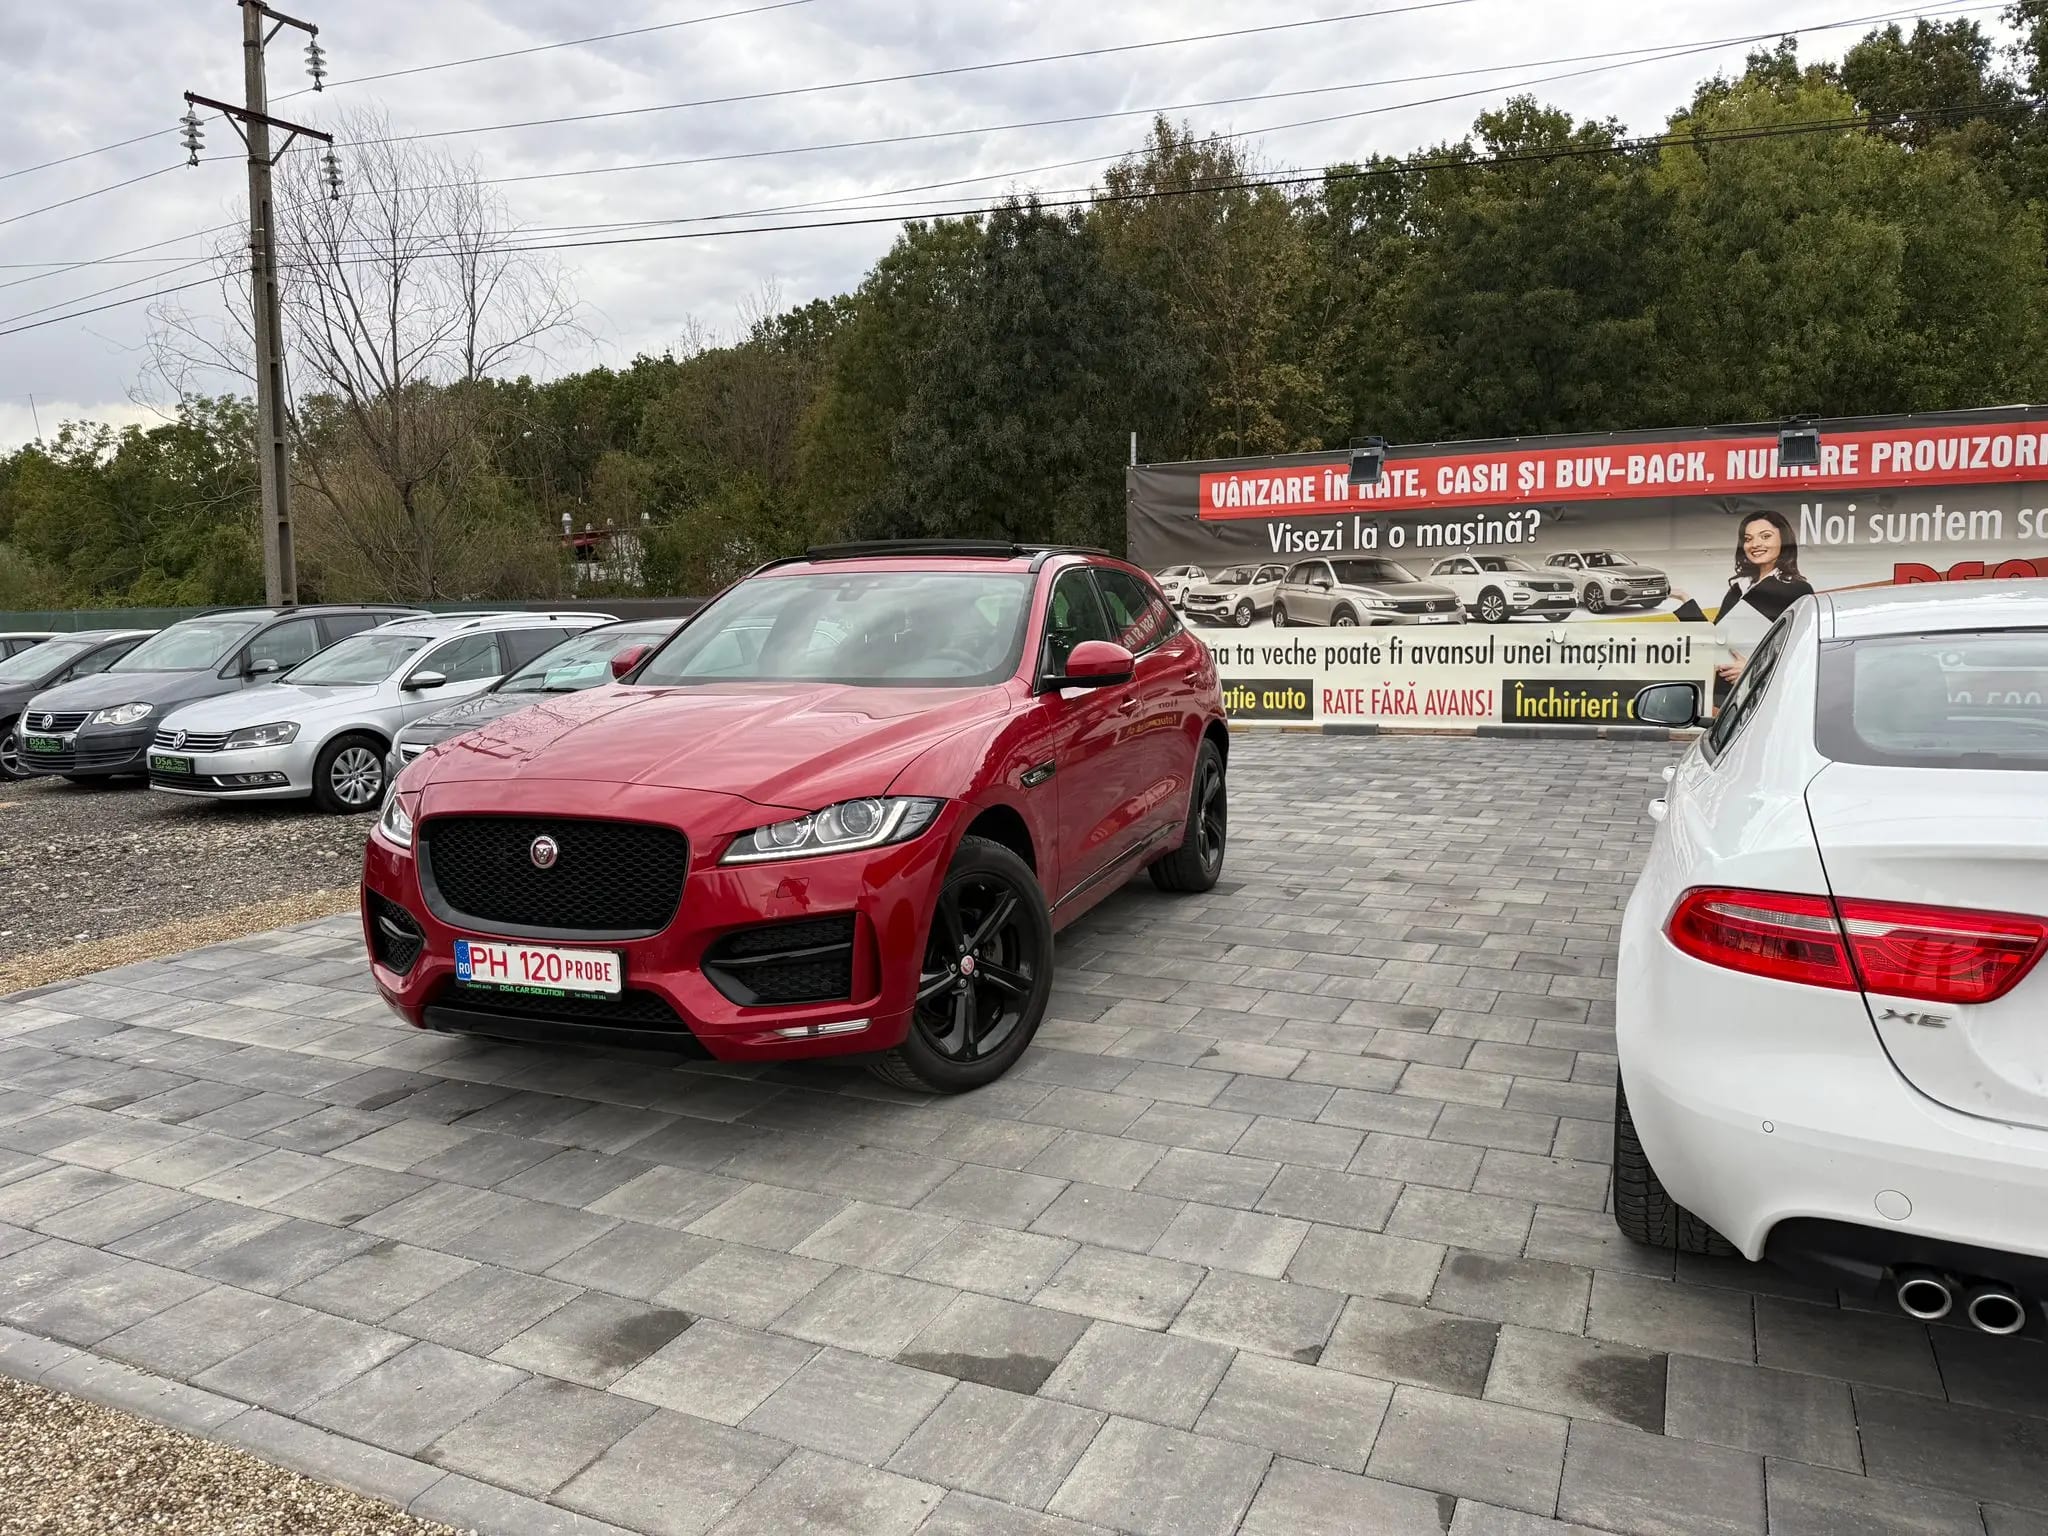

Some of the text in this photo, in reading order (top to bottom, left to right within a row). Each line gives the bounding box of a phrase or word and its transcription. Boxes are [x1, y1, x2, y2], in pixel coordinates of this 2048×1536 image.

[1211, 475, 1315, 508] VÂNZARE
[1324, 469, 1348, 501] ÎN
[1437, 463, 1507, 495] CASH
[1517, 460, 1545, 496] ȘI
[1267, 509, 1541, 553] Visezi la o mașină?
[1800, 503, 1856, 545] Noi
[1869, 505, 2002, 543] suntem
[1236, 643, 1254, 665] ta
[1262, 637, 1316, 665] veche
[1325, 642, 1381, 671] poate
[1389, 636, 1403, 665] fi
[1411, 634, 1494, 665] avansul
[1503, 638, 1551, 664] unei
[1560, 637, 1636, 671] mașini
[1646, 636, 1691, 664] noi!
[1263, 687, 1306, 710] auto
[1323, 681, 1493, 716] RATE FĂRĂ AVANS!
[1515, 681, 1619, 718] Închirieri
[155, 757, 172, 766] DSA
[458, 962, 471, 976] RO
[470, 946, 613, 983] PH 120 PROBE
[499, 984, 514, 993] DSA
[515, 986, 530, 994] CAR
[530, 987, 565, 997] SOLUTION
[1878, 1007, 1952, 1029] XE
